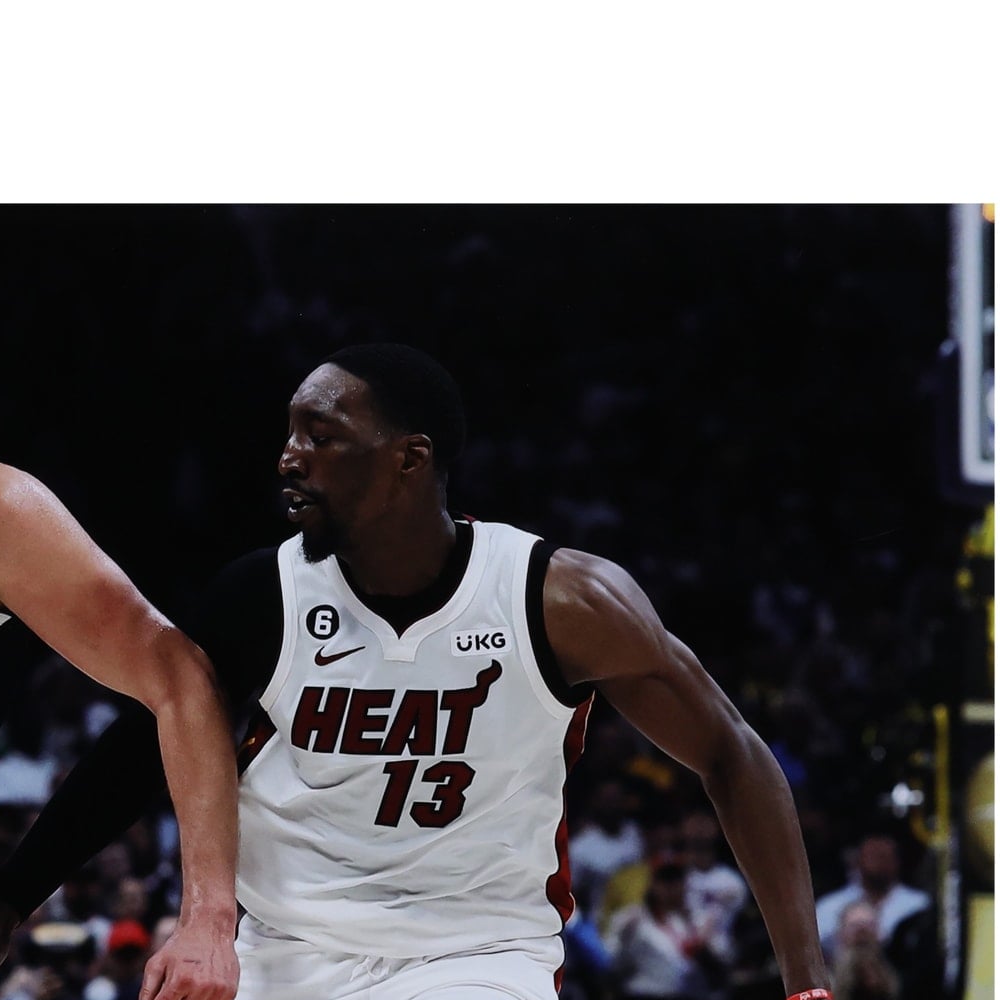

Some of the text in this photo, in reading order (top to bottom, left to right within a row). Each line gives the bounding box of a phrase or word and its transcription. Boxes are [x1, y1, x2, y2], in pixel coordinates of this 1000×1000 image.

[314, 609, 333, 635] 6
[291, 658, 503, 756] HEAT
[374, 759, 476, 828] 13
